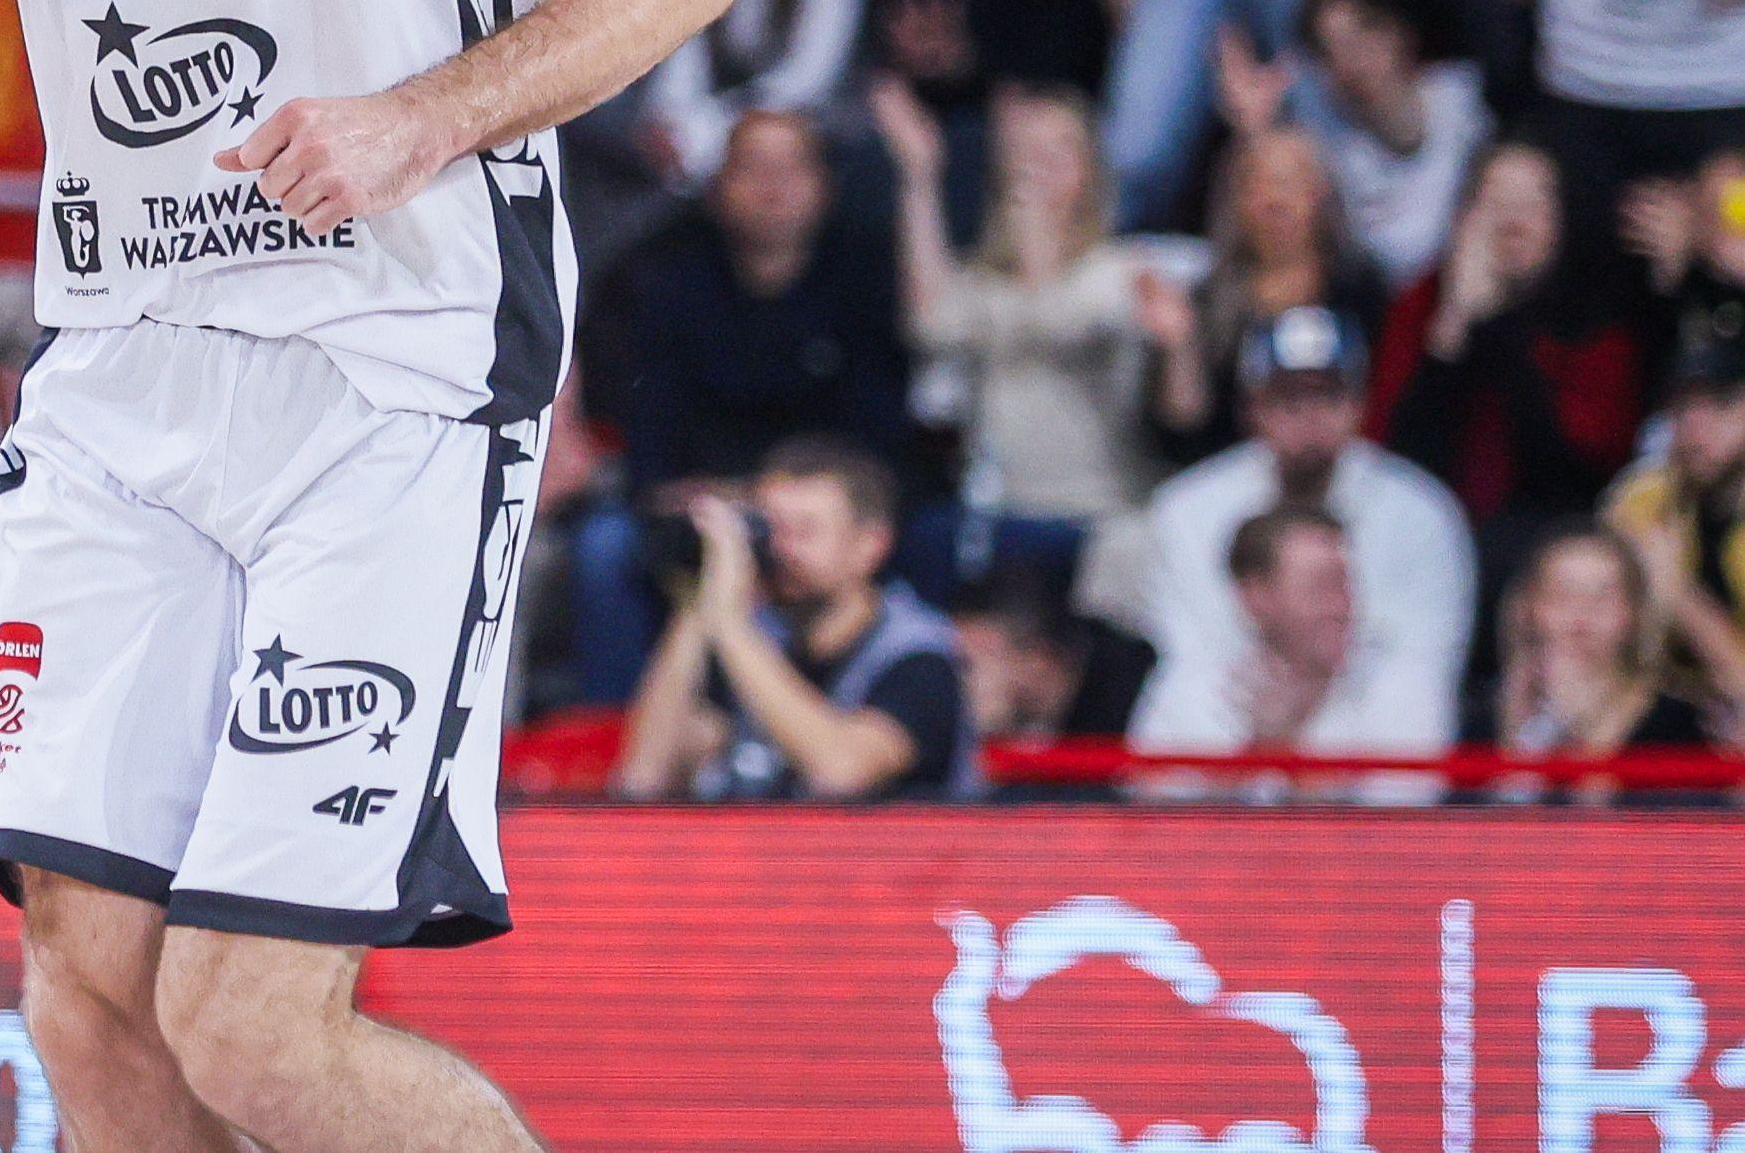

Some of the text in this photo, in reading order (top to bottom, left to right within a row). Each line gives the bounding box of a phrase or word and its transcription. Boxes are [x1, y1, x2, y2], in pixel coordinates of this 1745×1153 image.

[111, 40, 235, 125] LOTTO
[258, 680, 379, 735] LOTTO
[312, 785, 398, 826] 4F
